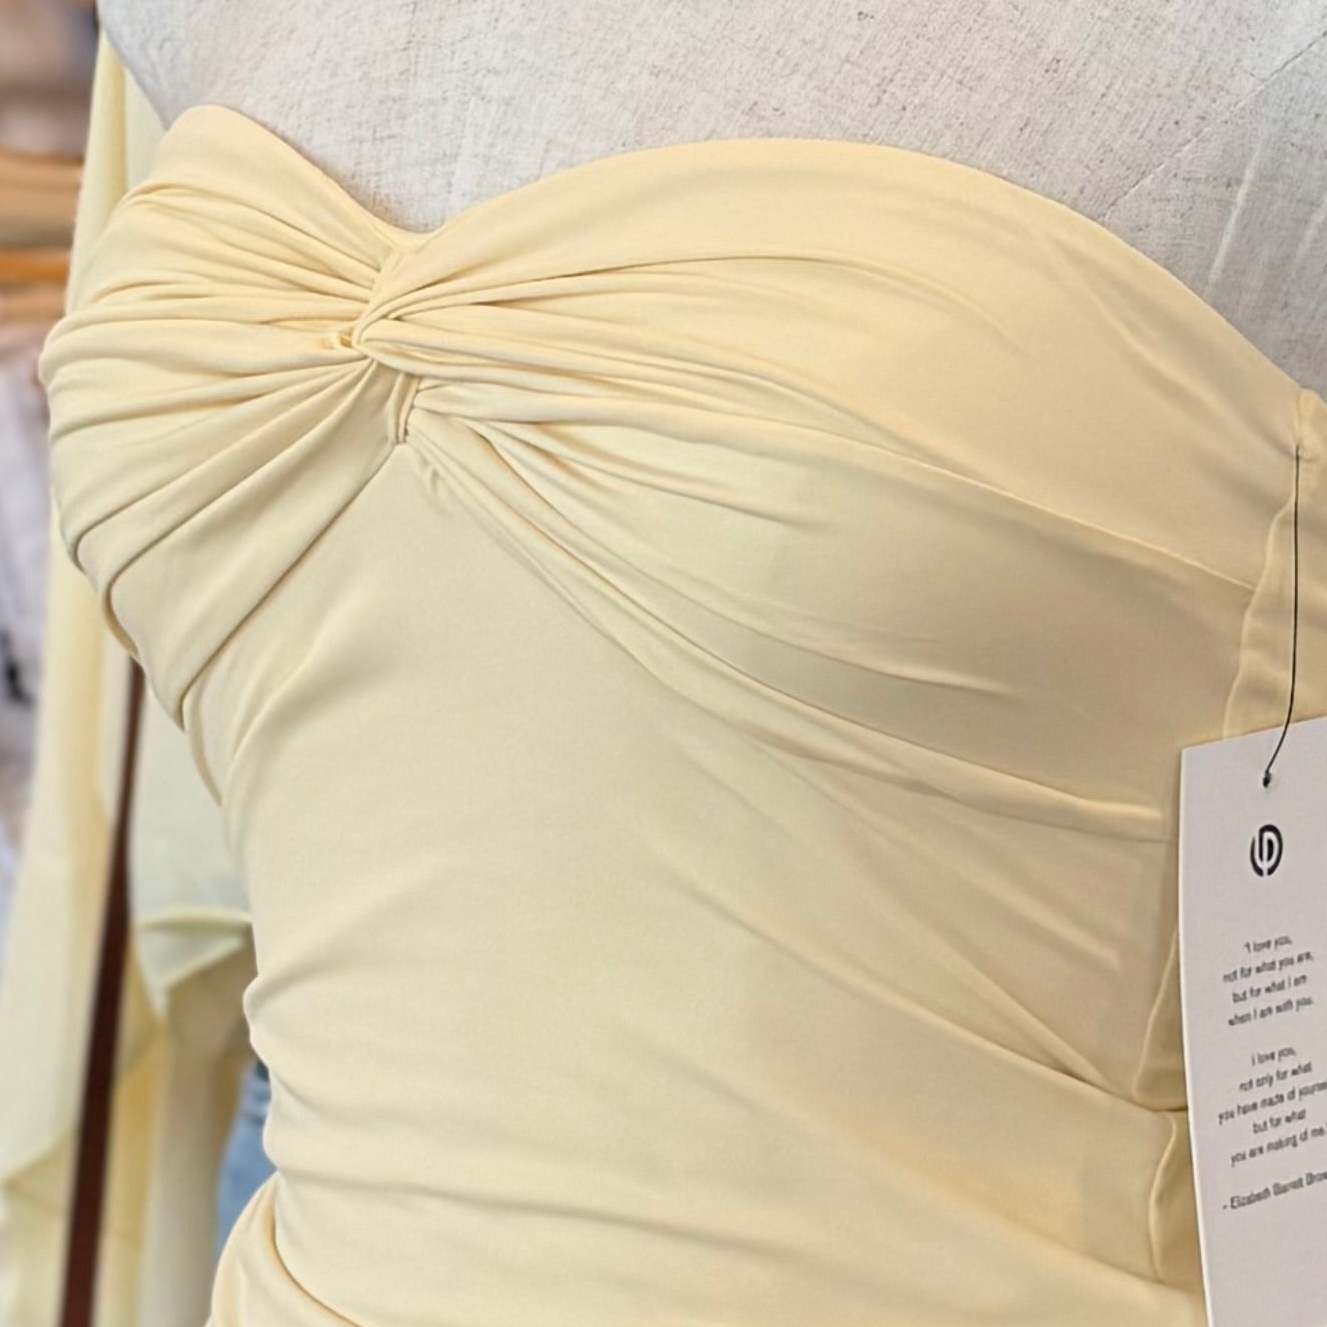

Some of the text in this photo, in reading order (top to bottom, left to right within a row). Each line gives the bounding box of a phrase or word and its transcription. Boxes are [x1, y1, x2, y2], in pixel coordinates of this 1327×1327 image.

[1278, 957, 1294, 971] you
[1218, 1111, 1235, 1125] you
[1231, 1152, 1247, 1167] you
